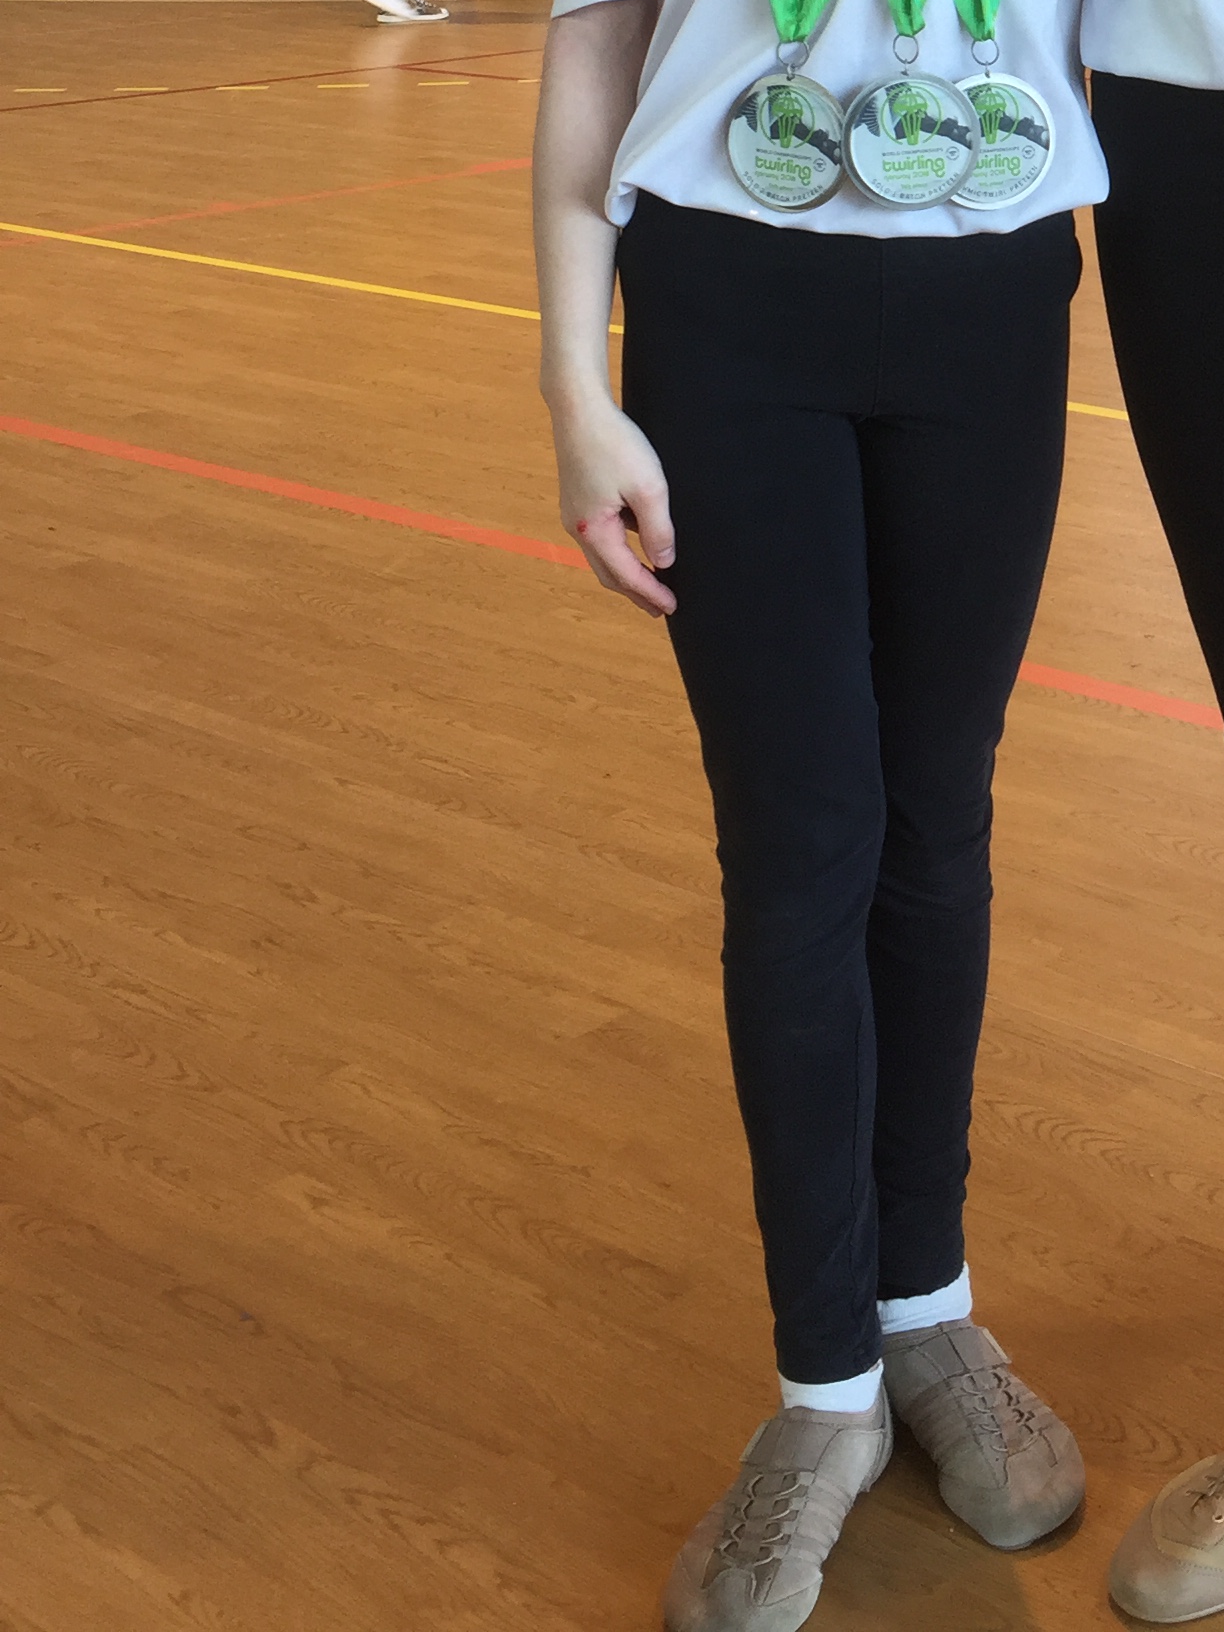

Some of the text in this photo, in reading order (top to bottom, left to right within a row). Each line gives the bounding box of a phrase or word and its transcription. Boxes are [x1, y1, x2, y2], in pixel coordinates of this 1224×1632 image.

[755, 155, 812, 186] twirling
[882, 155, 946, 178] twirling
[976, 154, 1021, 176] wirling
